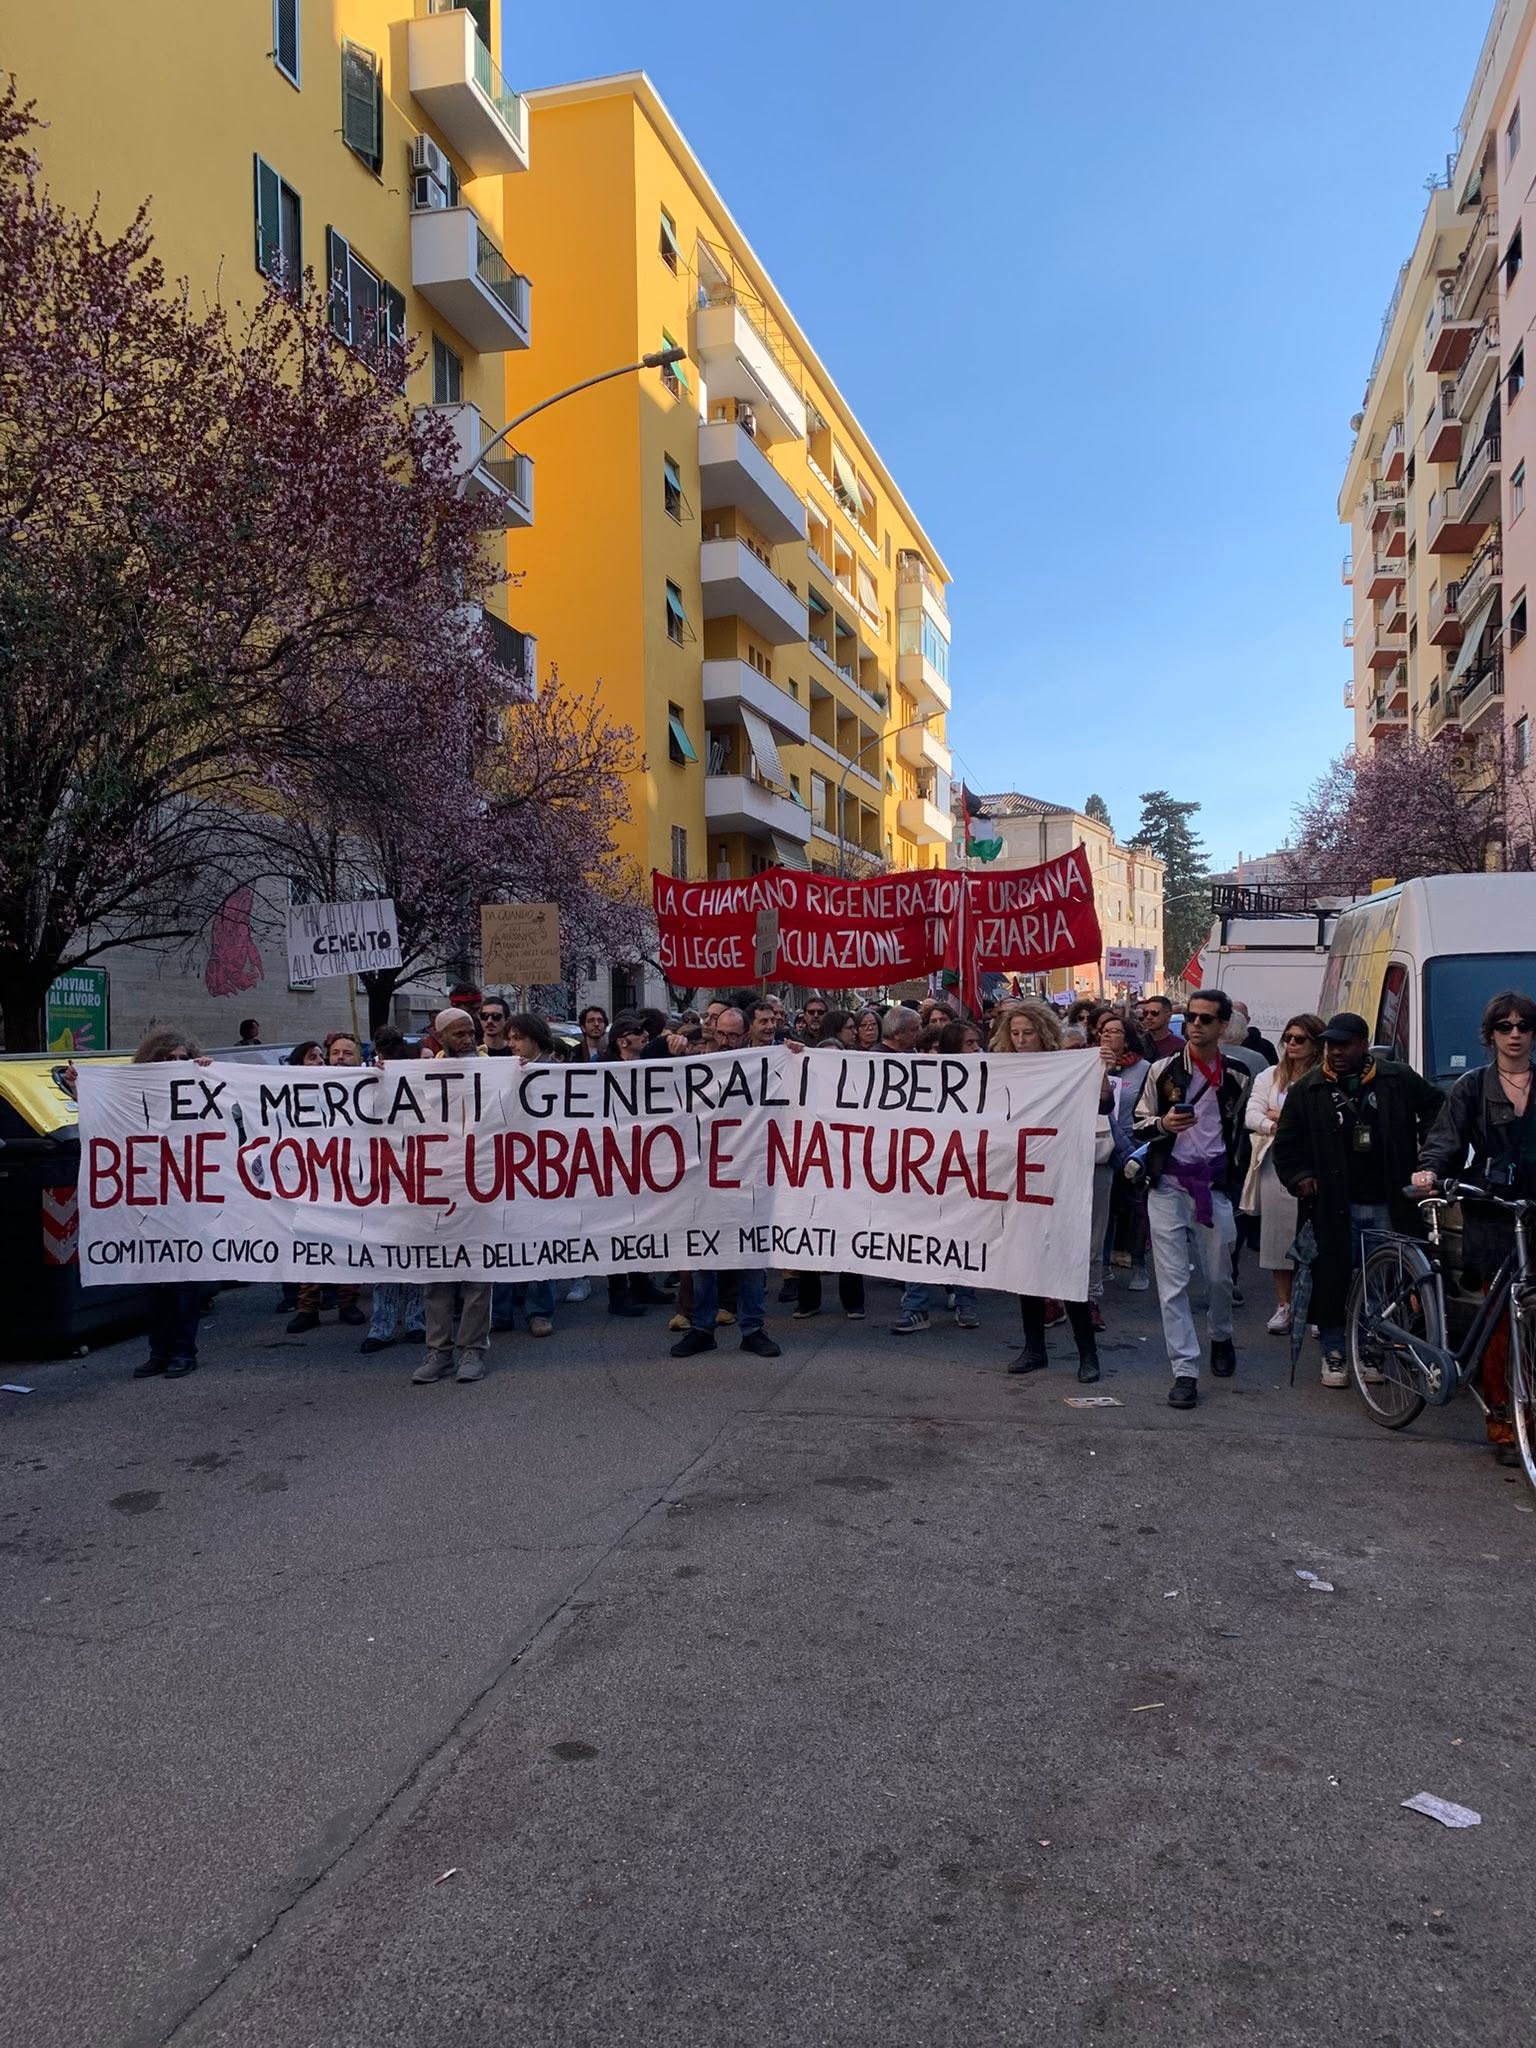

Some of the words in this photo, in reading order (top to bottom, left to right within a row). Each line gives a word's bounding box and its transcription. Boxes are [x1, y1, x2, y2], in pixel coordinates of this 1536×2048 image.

[656, 884, 678, 916] LA
[681, 876, 798, 917] CHIAMANO
[988, 857, 1088, 914] URBANA
[497, 909, 535, 921] QUANDO
[661, 933, 677, 967] SI
[683, 935, 746, 969] LEGGE
[924, 909, 1076, 957] FINNZIARIA
[292, 953, 319, 980] ALLA
[313, 930, 391, 955] CEMENTO
[49, 991, 62, 1006] AL
[64, 992, 102, 1008] LAVORO
[170, 1079, 227, 1120] EX
[259, 1072, 482, 1128] MERCATI
[518, 1056, 811, 1118] GENERALI
[835, 1058, 989, 1114] LIBERI
[89, 1132, 227, 1209] BENE
[236, 1133, 457, 1217] COMUNE,
[465, 1123, 686, 1204] URBANO
[708, 1118, 743, 1189] E
[766, 1118, 1059, 1206] NATURALE
[87, 1239, 203, 1265] COMITATO
[212, 1238, 279, 1263] CIVICO
[292, 1240, 336, 1266] PER
[347, 1243, 375, 1268] LA
[380, 1244, 472, 1270] TUTELA
[482, 1237, 600, 1269] DELL'AREA
[611, 1232, 670, 1262] DEGLI
[686, 1228, 721, 1257] EX
[738, 1225, 836, 1258] MERCATI
[851, 1230, 988, 1273] GENERALI
